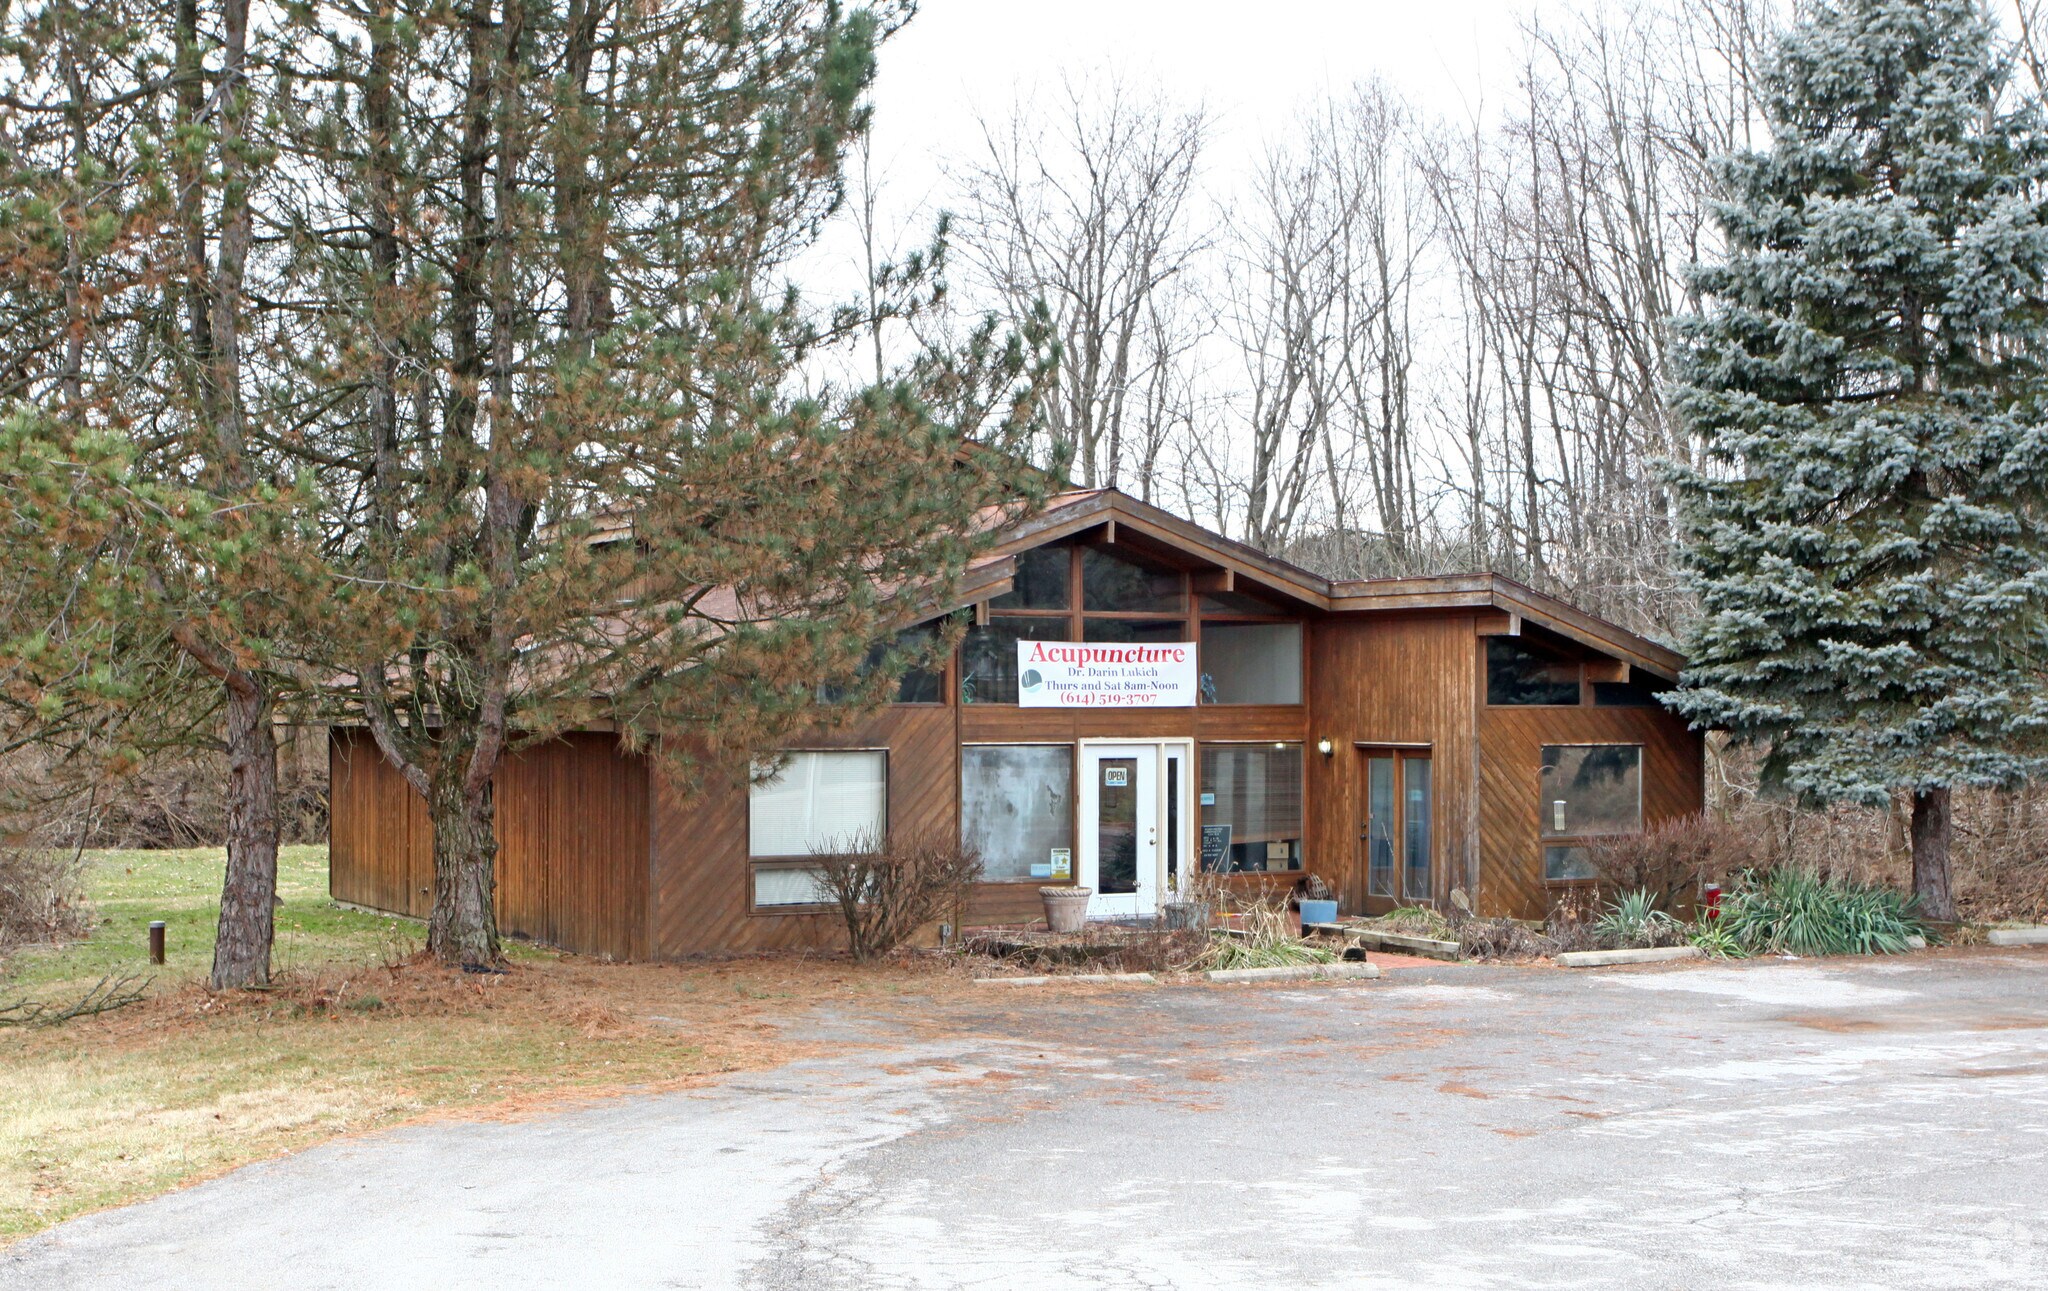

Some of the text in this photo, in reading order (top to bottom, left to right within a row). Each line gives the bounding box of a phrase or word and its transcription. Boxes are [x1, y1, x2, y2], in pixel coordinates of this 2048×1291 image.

[1029, 642, 1185, 668] Acupuncture
[1068, 667, 1158, 677] Dr. Darin Lukich
[1045, 681, 1179, 690] Thurs and Sat 8am-Noon
[1060, 691, 1158, 706] (614) 519-3707
[1108, 771, 1125, 780] OPEN
